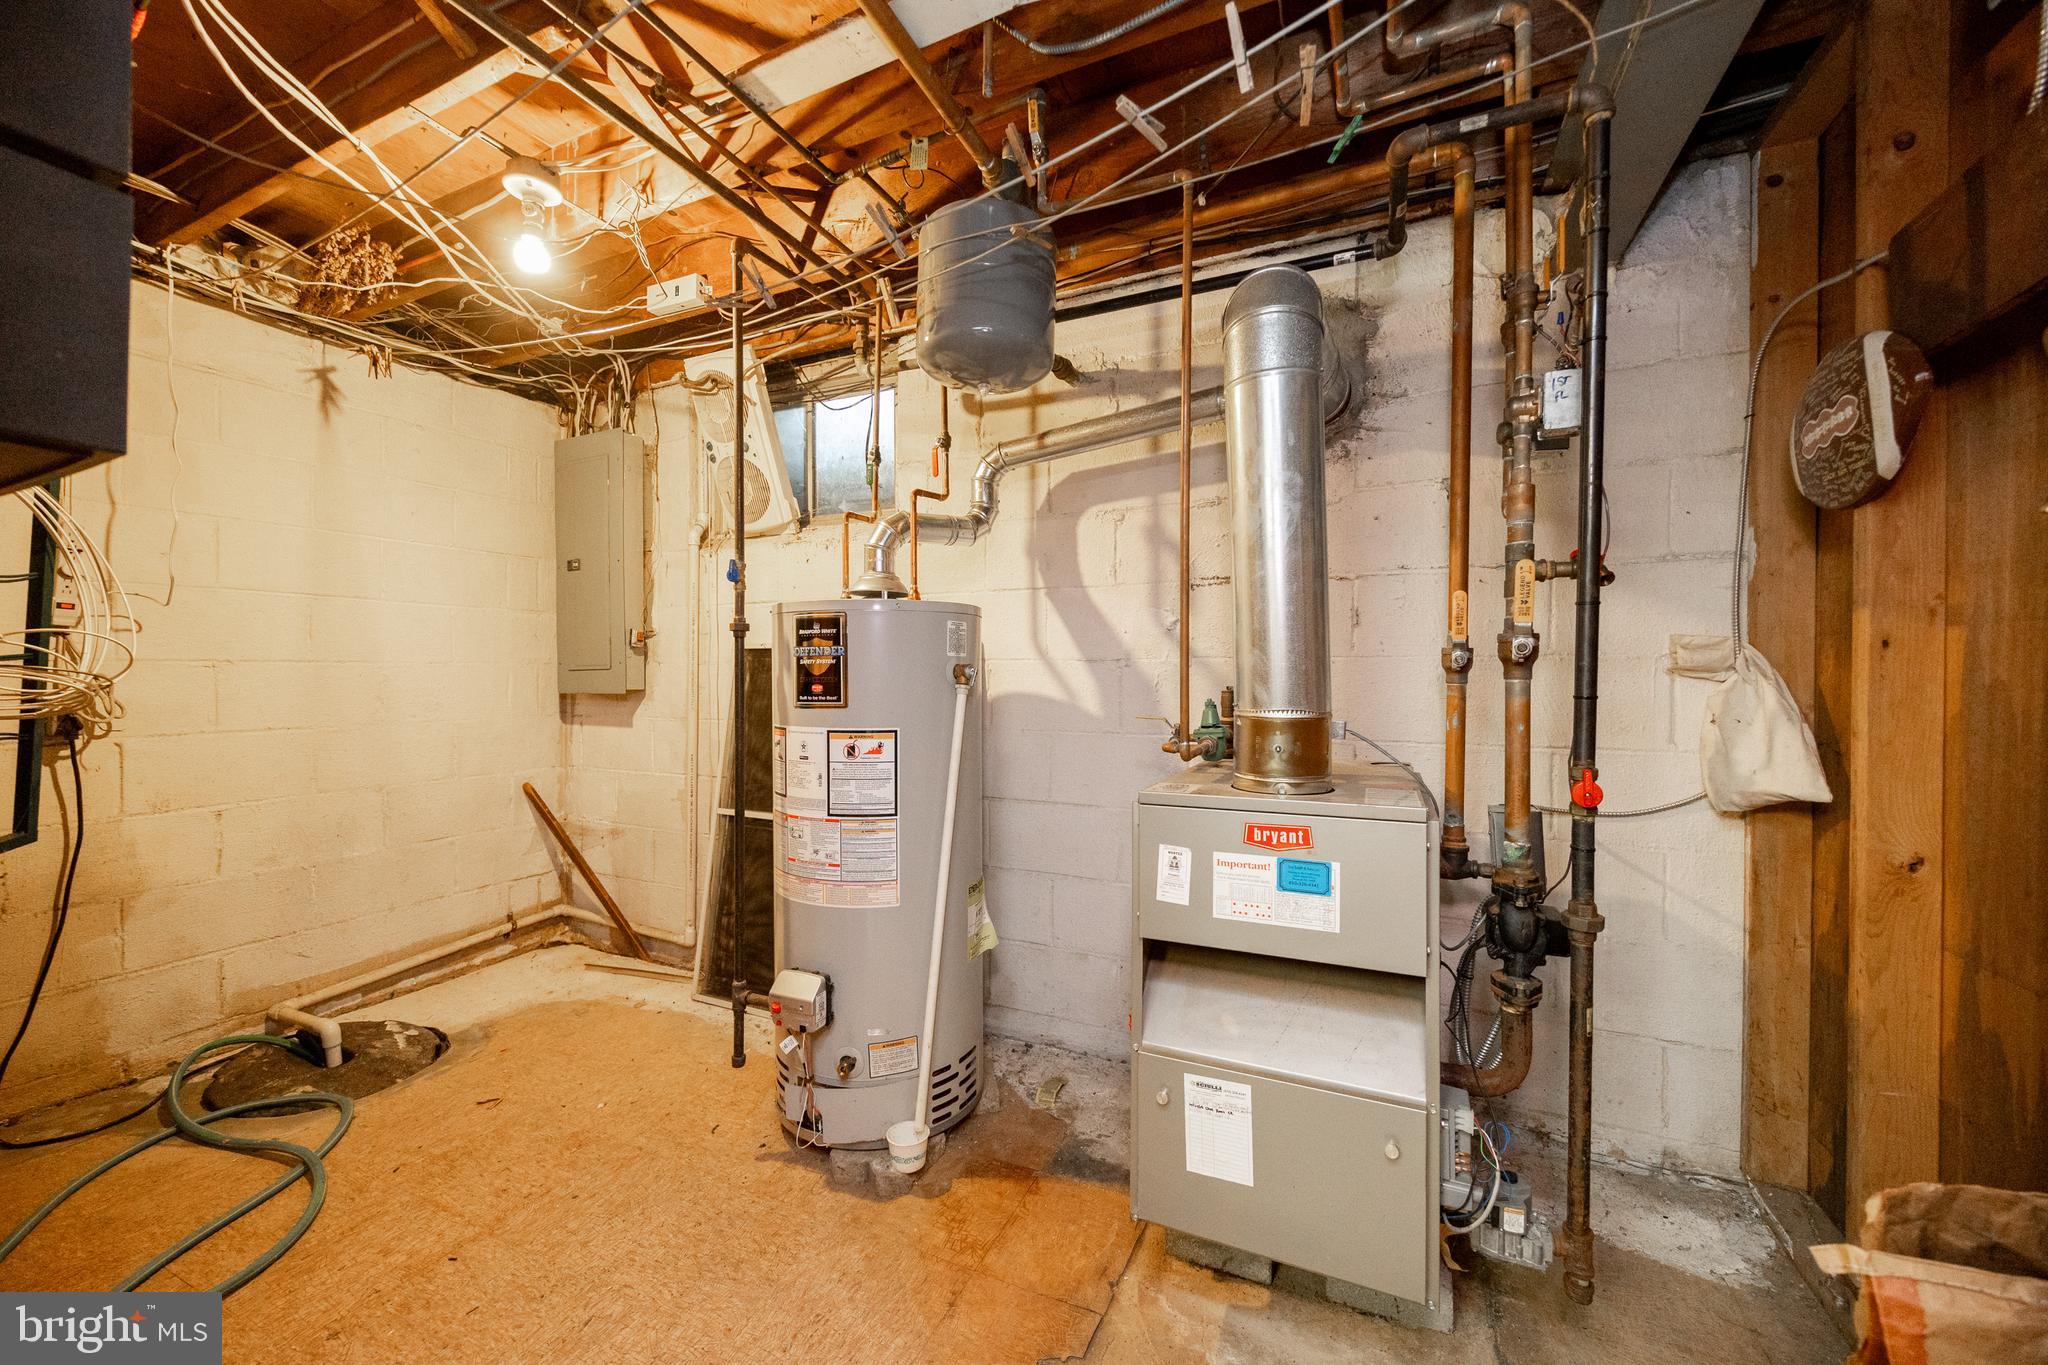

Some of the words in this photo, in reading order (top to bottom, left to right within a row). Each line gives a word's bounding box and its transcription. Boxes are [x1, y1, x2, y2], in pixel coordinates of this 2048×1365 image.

[794, 646, 845, 656] DEFENDER
[1253, 827, 1303, 844] bryant
[1216, 858, 1271, 871] Important!
